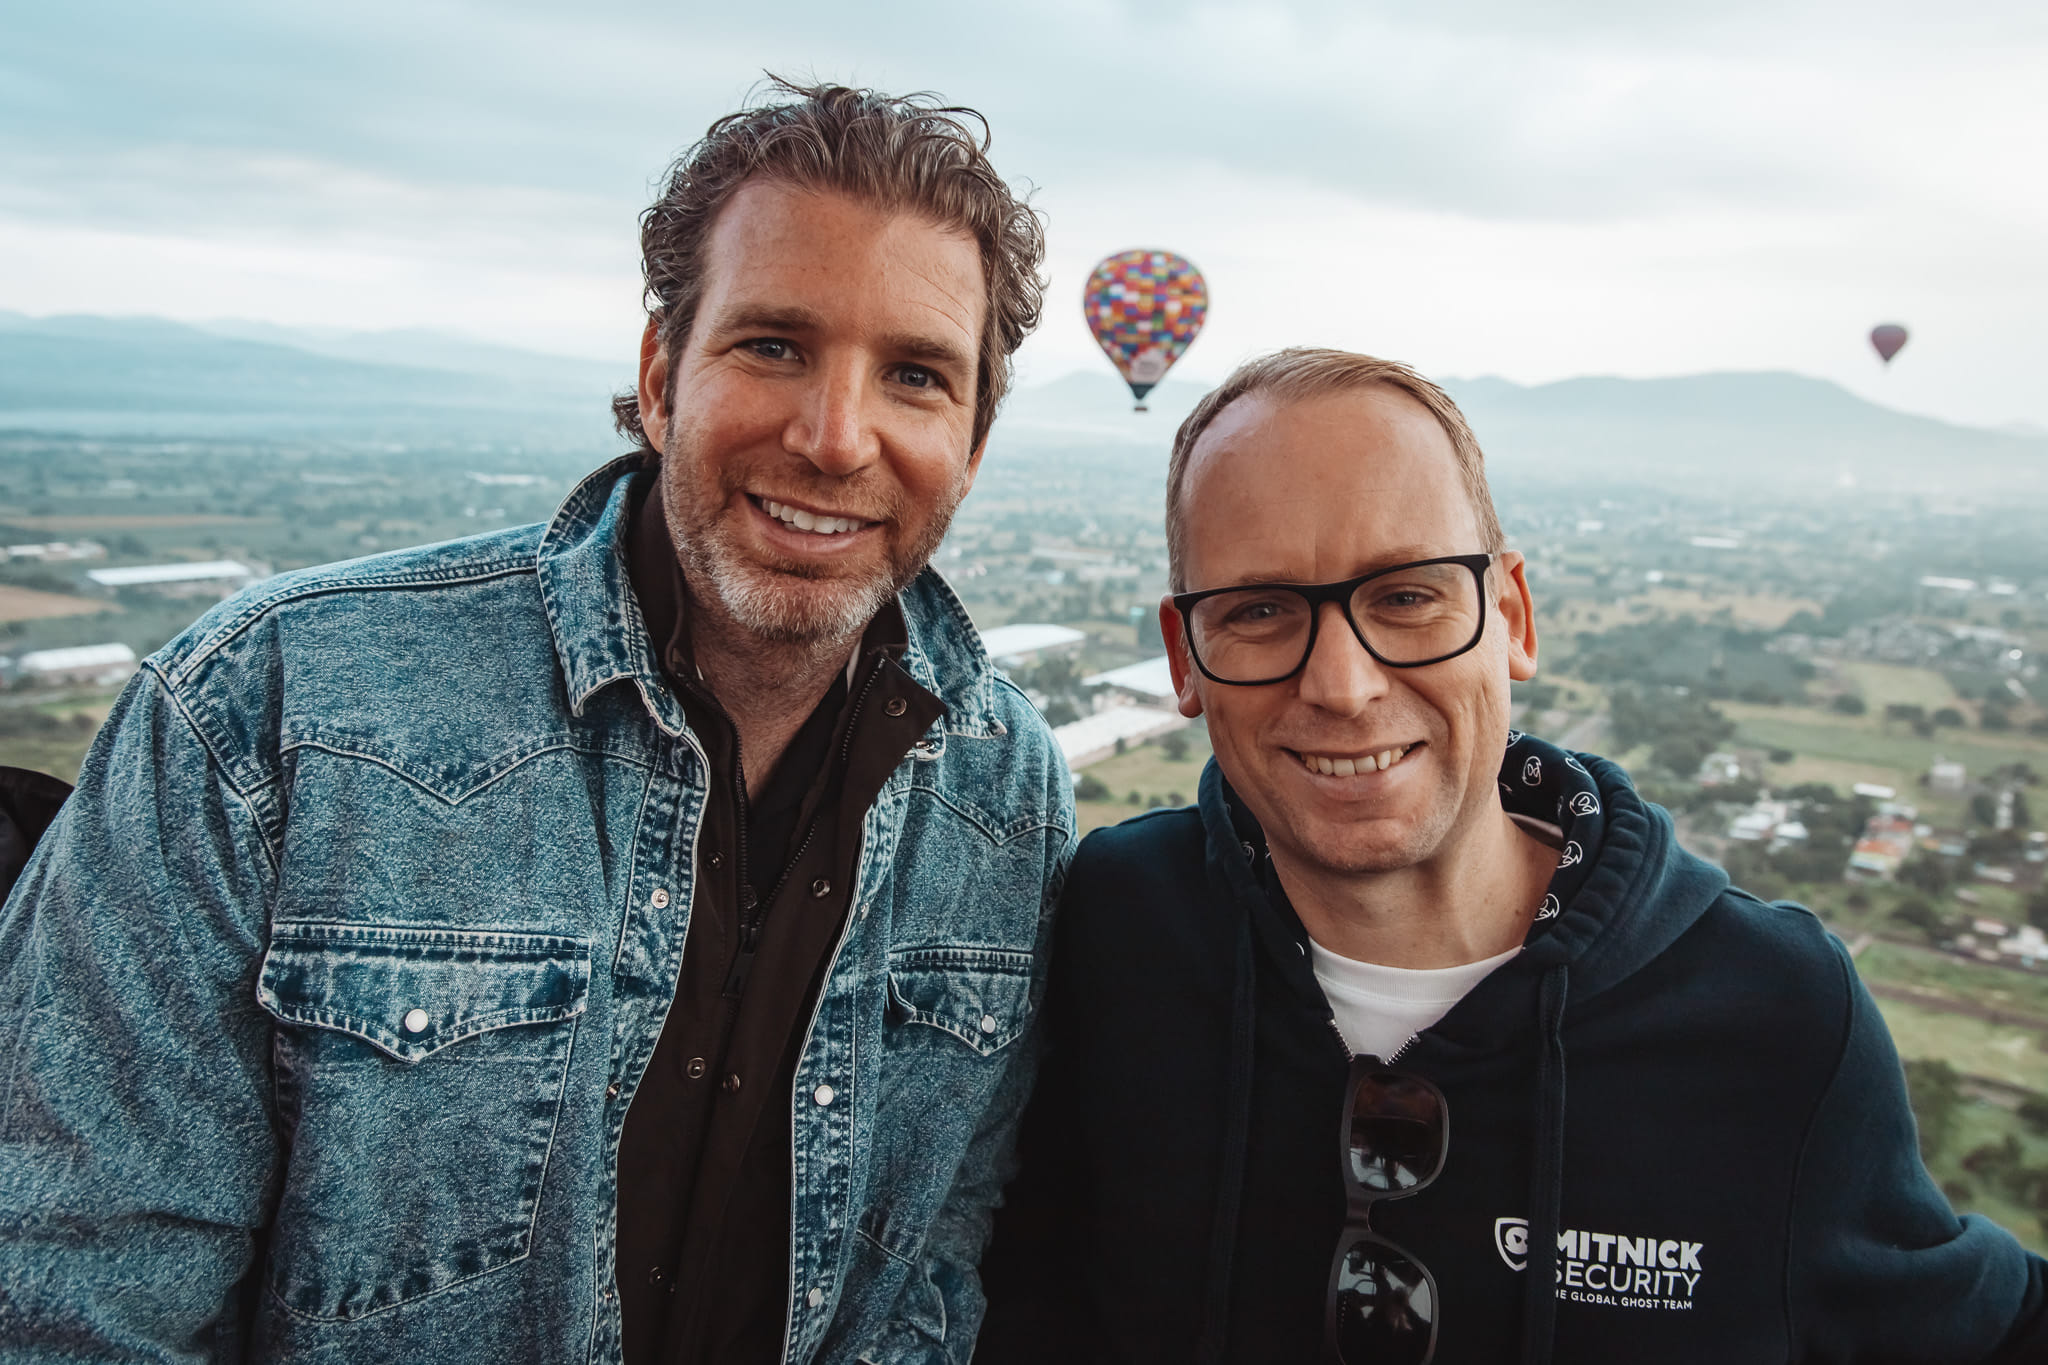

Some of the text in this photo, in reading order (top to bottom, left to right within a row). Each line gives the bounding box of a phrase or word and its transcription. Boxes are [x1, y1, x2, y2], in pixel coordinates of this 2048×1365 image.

[1557, 1229, 1703, 1271] MITNICK
[1570, 1291, 1617, 1306] GLOBAL
[1621, 1297, 1660, 1309] GHOST
[1663, 1300, 1693, 1310] TEAM
